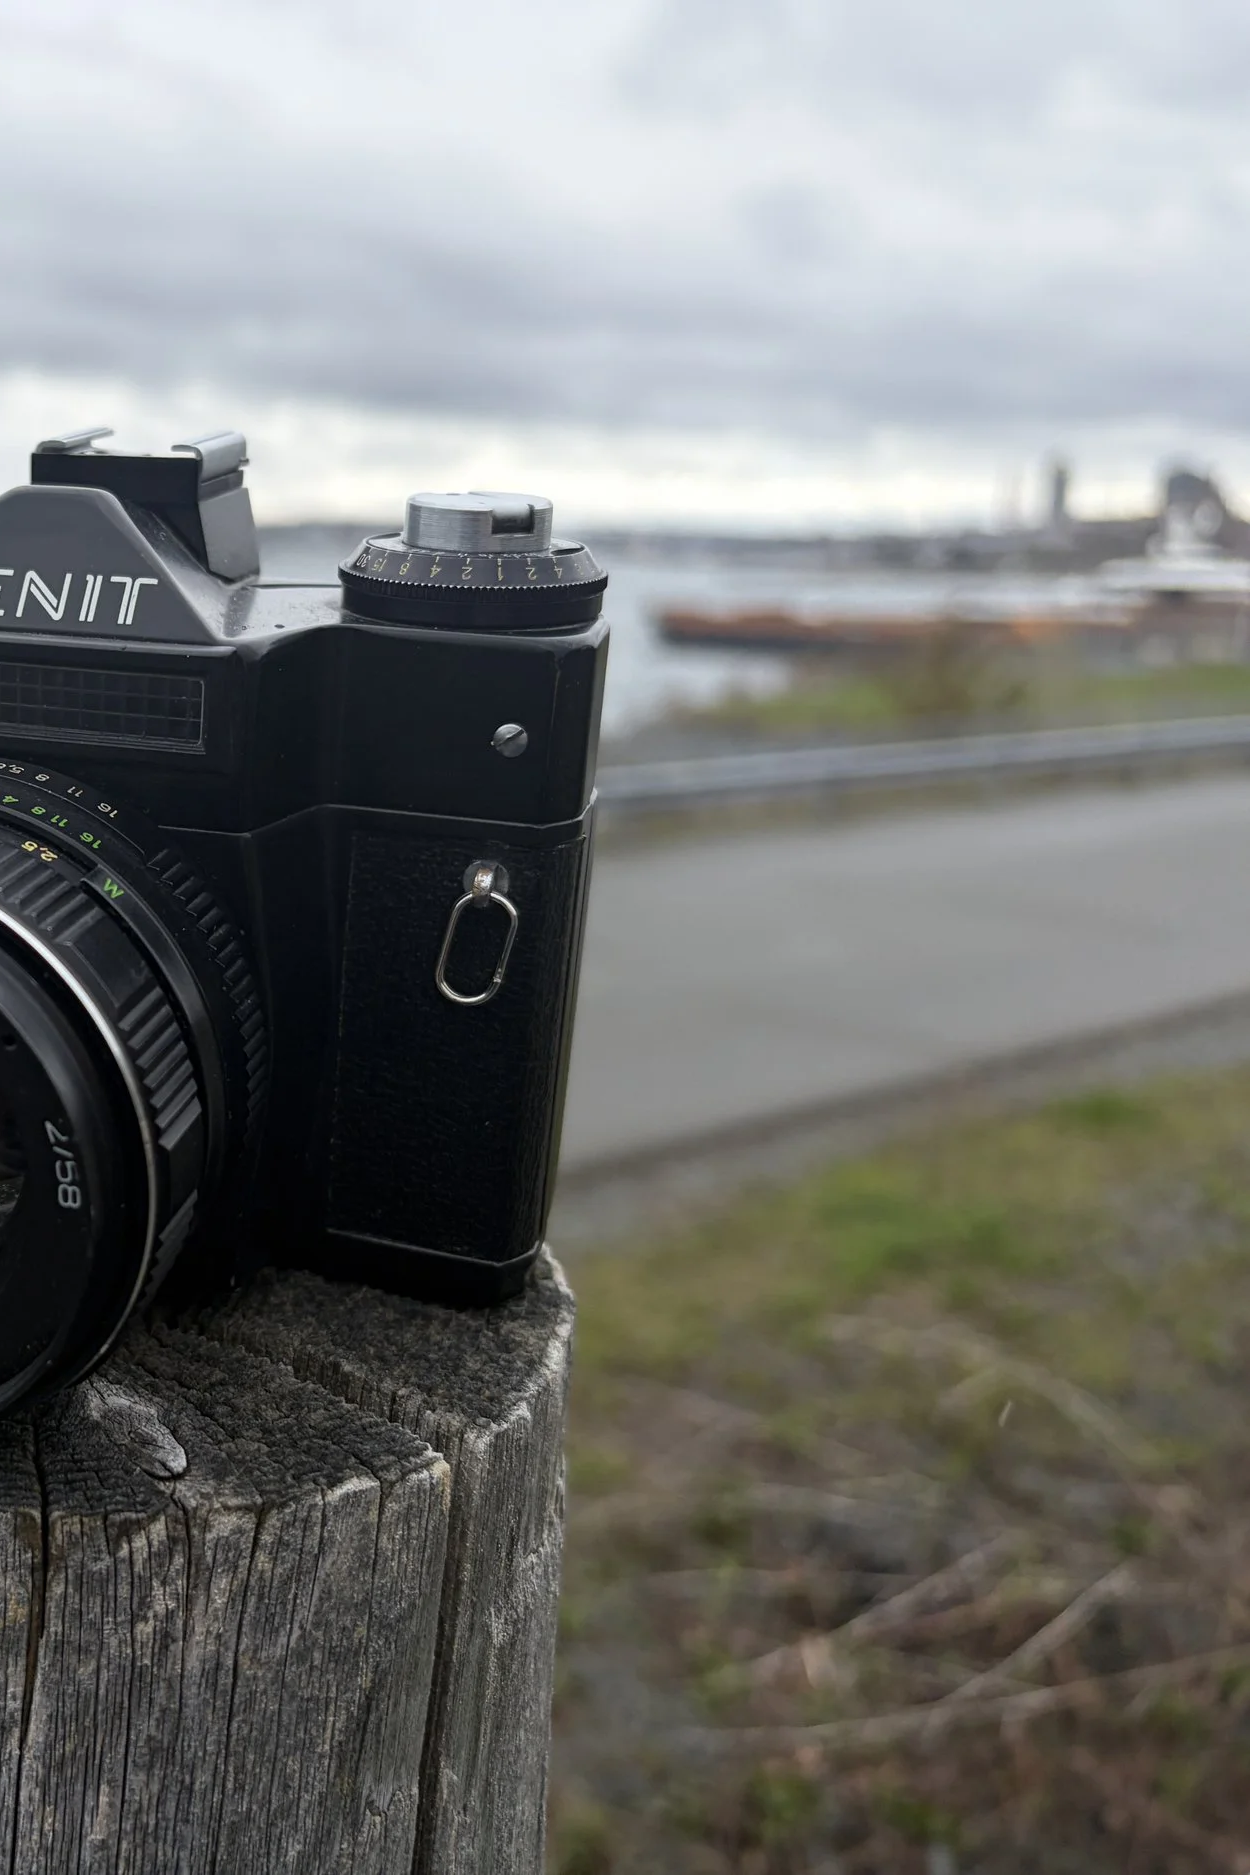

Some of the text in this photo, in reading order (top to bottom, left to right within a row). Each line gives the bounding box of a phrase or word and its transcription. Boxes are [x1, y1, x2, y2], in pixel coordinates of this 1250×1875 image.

[356, 553, 371, 568] 30
[372, 558, 387, 573] 15
[399, 562, 410, 576] 8
[430, 565, 442, 578] 4
[462, 566, 473, 580] 2
[525, 567, 537, 580] 2
[35, 773, 50, 781] 8
[67, 786, 84, 797] 11
[2, 795, 19, 805] 4
[31, 806, 46, 815] 8
[97, 802, 119, 818] 16
[50, 815, 69, 827] 11
[79, 832, 102, 849] 16
[103, 878, 124, 899] M
[44, 1120, 82, 1209] 2/58
